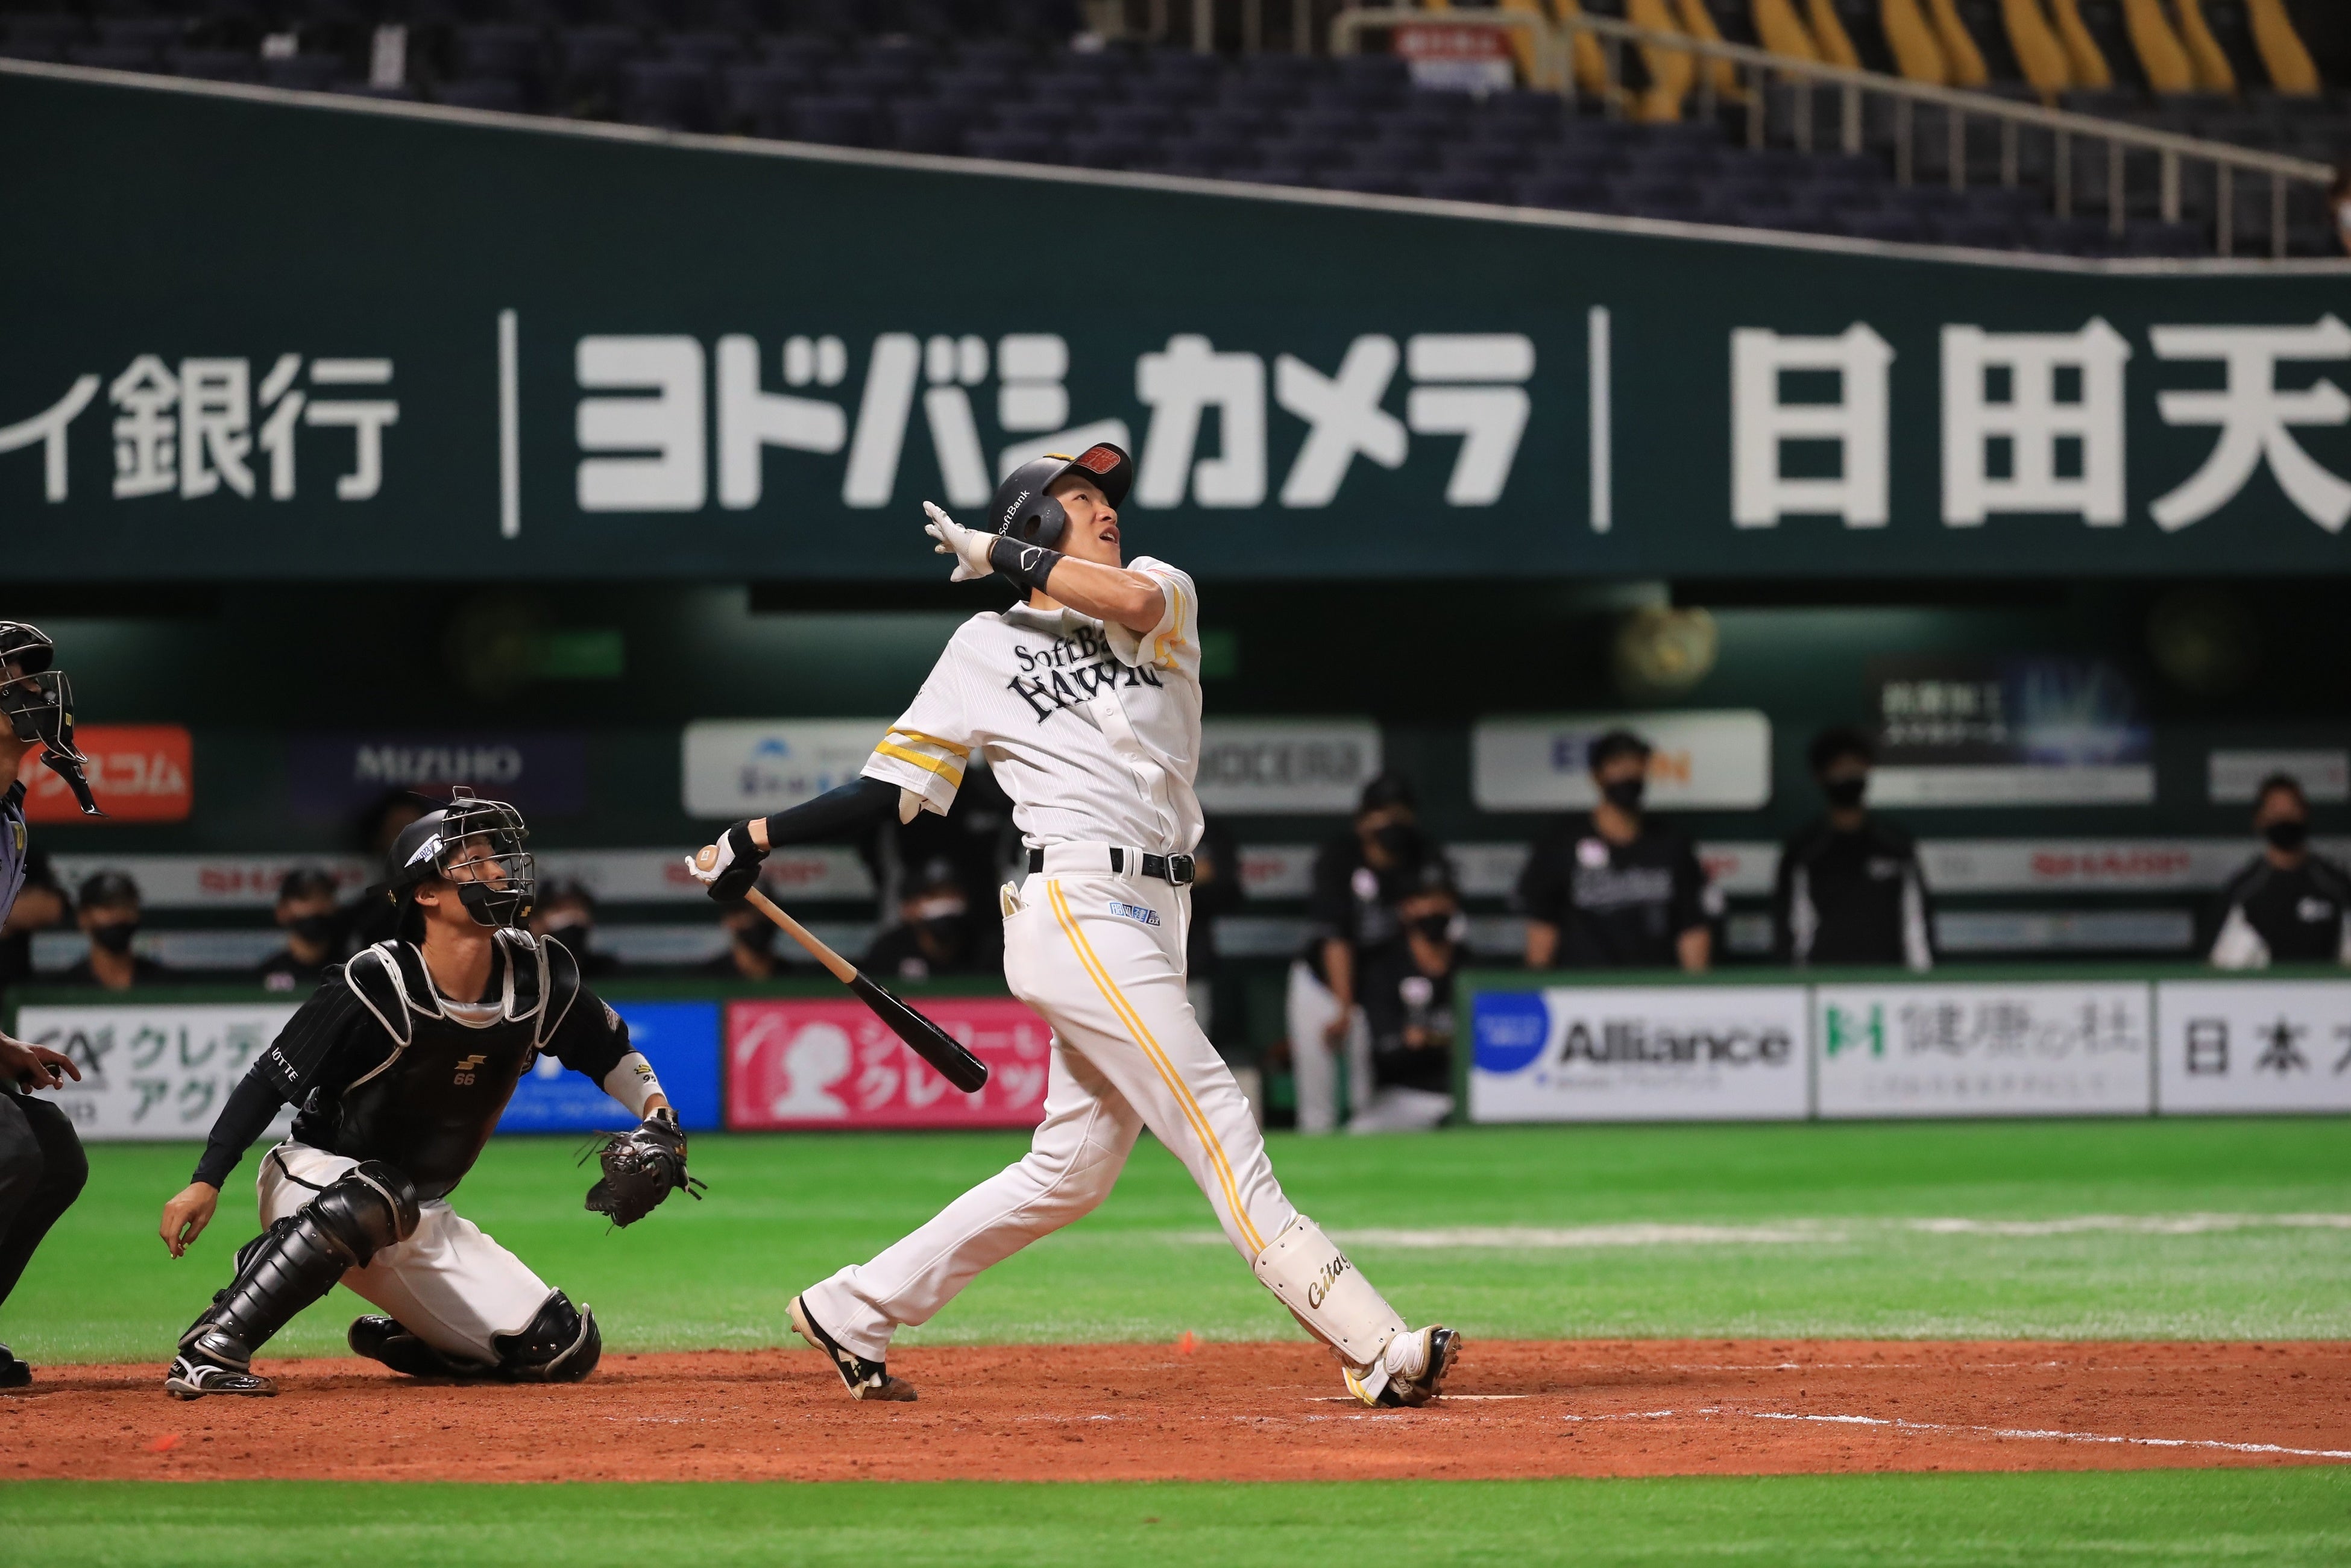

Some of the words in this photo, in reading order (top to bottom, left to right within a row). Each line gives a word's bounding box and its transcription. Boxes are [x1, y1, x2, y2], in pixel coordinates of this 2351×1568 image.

[575, 332, 1536, 512] ヨドバシカメラ
[998, 490, 1030, 537] SoftBank
[1200, 741, 1360, 785] OCERA
[272, 1047, 299, 1082] LOTTE
[1560, 1019, 1790, 1066] Alliance
[454, 1073, 476, 1086] 66
